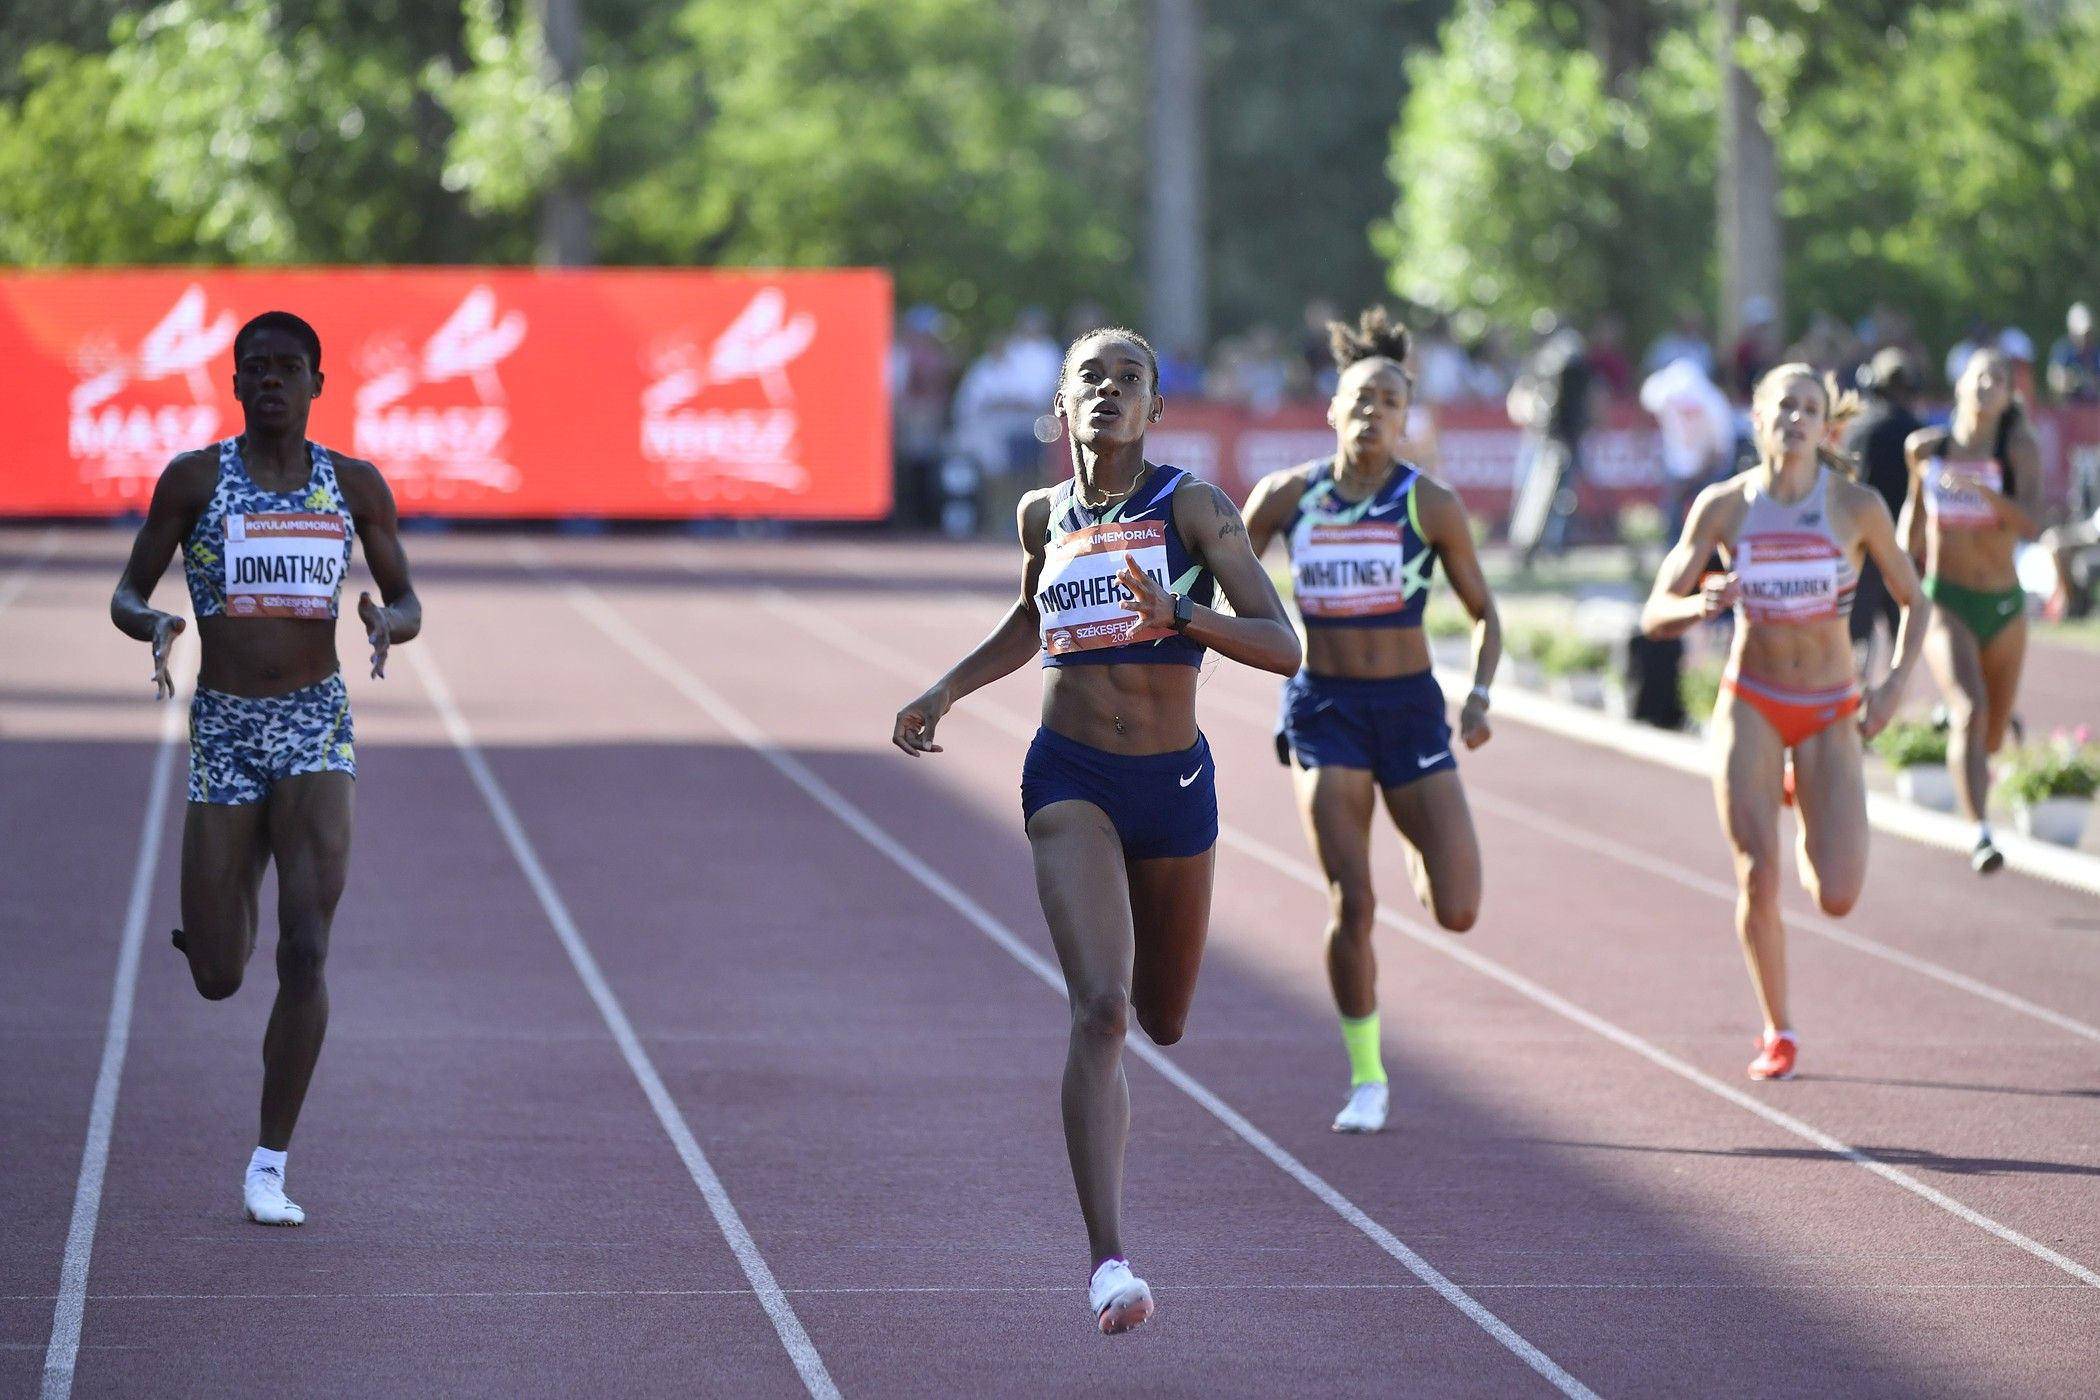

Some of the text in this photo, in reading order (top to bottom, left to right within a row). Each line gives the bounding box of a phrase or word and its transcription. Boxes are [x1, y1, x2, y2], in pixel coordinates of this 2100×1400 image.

[245, 520, 342, 532] #GYULAIMEMORIAL
[1087, 529, 1161, 545] AIMEMORIAL
[232, 555, 336, 585] JONATHAS
[1301, 560, 1395, 587] WHITNEY
[1040, 568, 1164, 614] MCPHERSN
[1076, 617, 1139, 639] SZÉKESFEH
